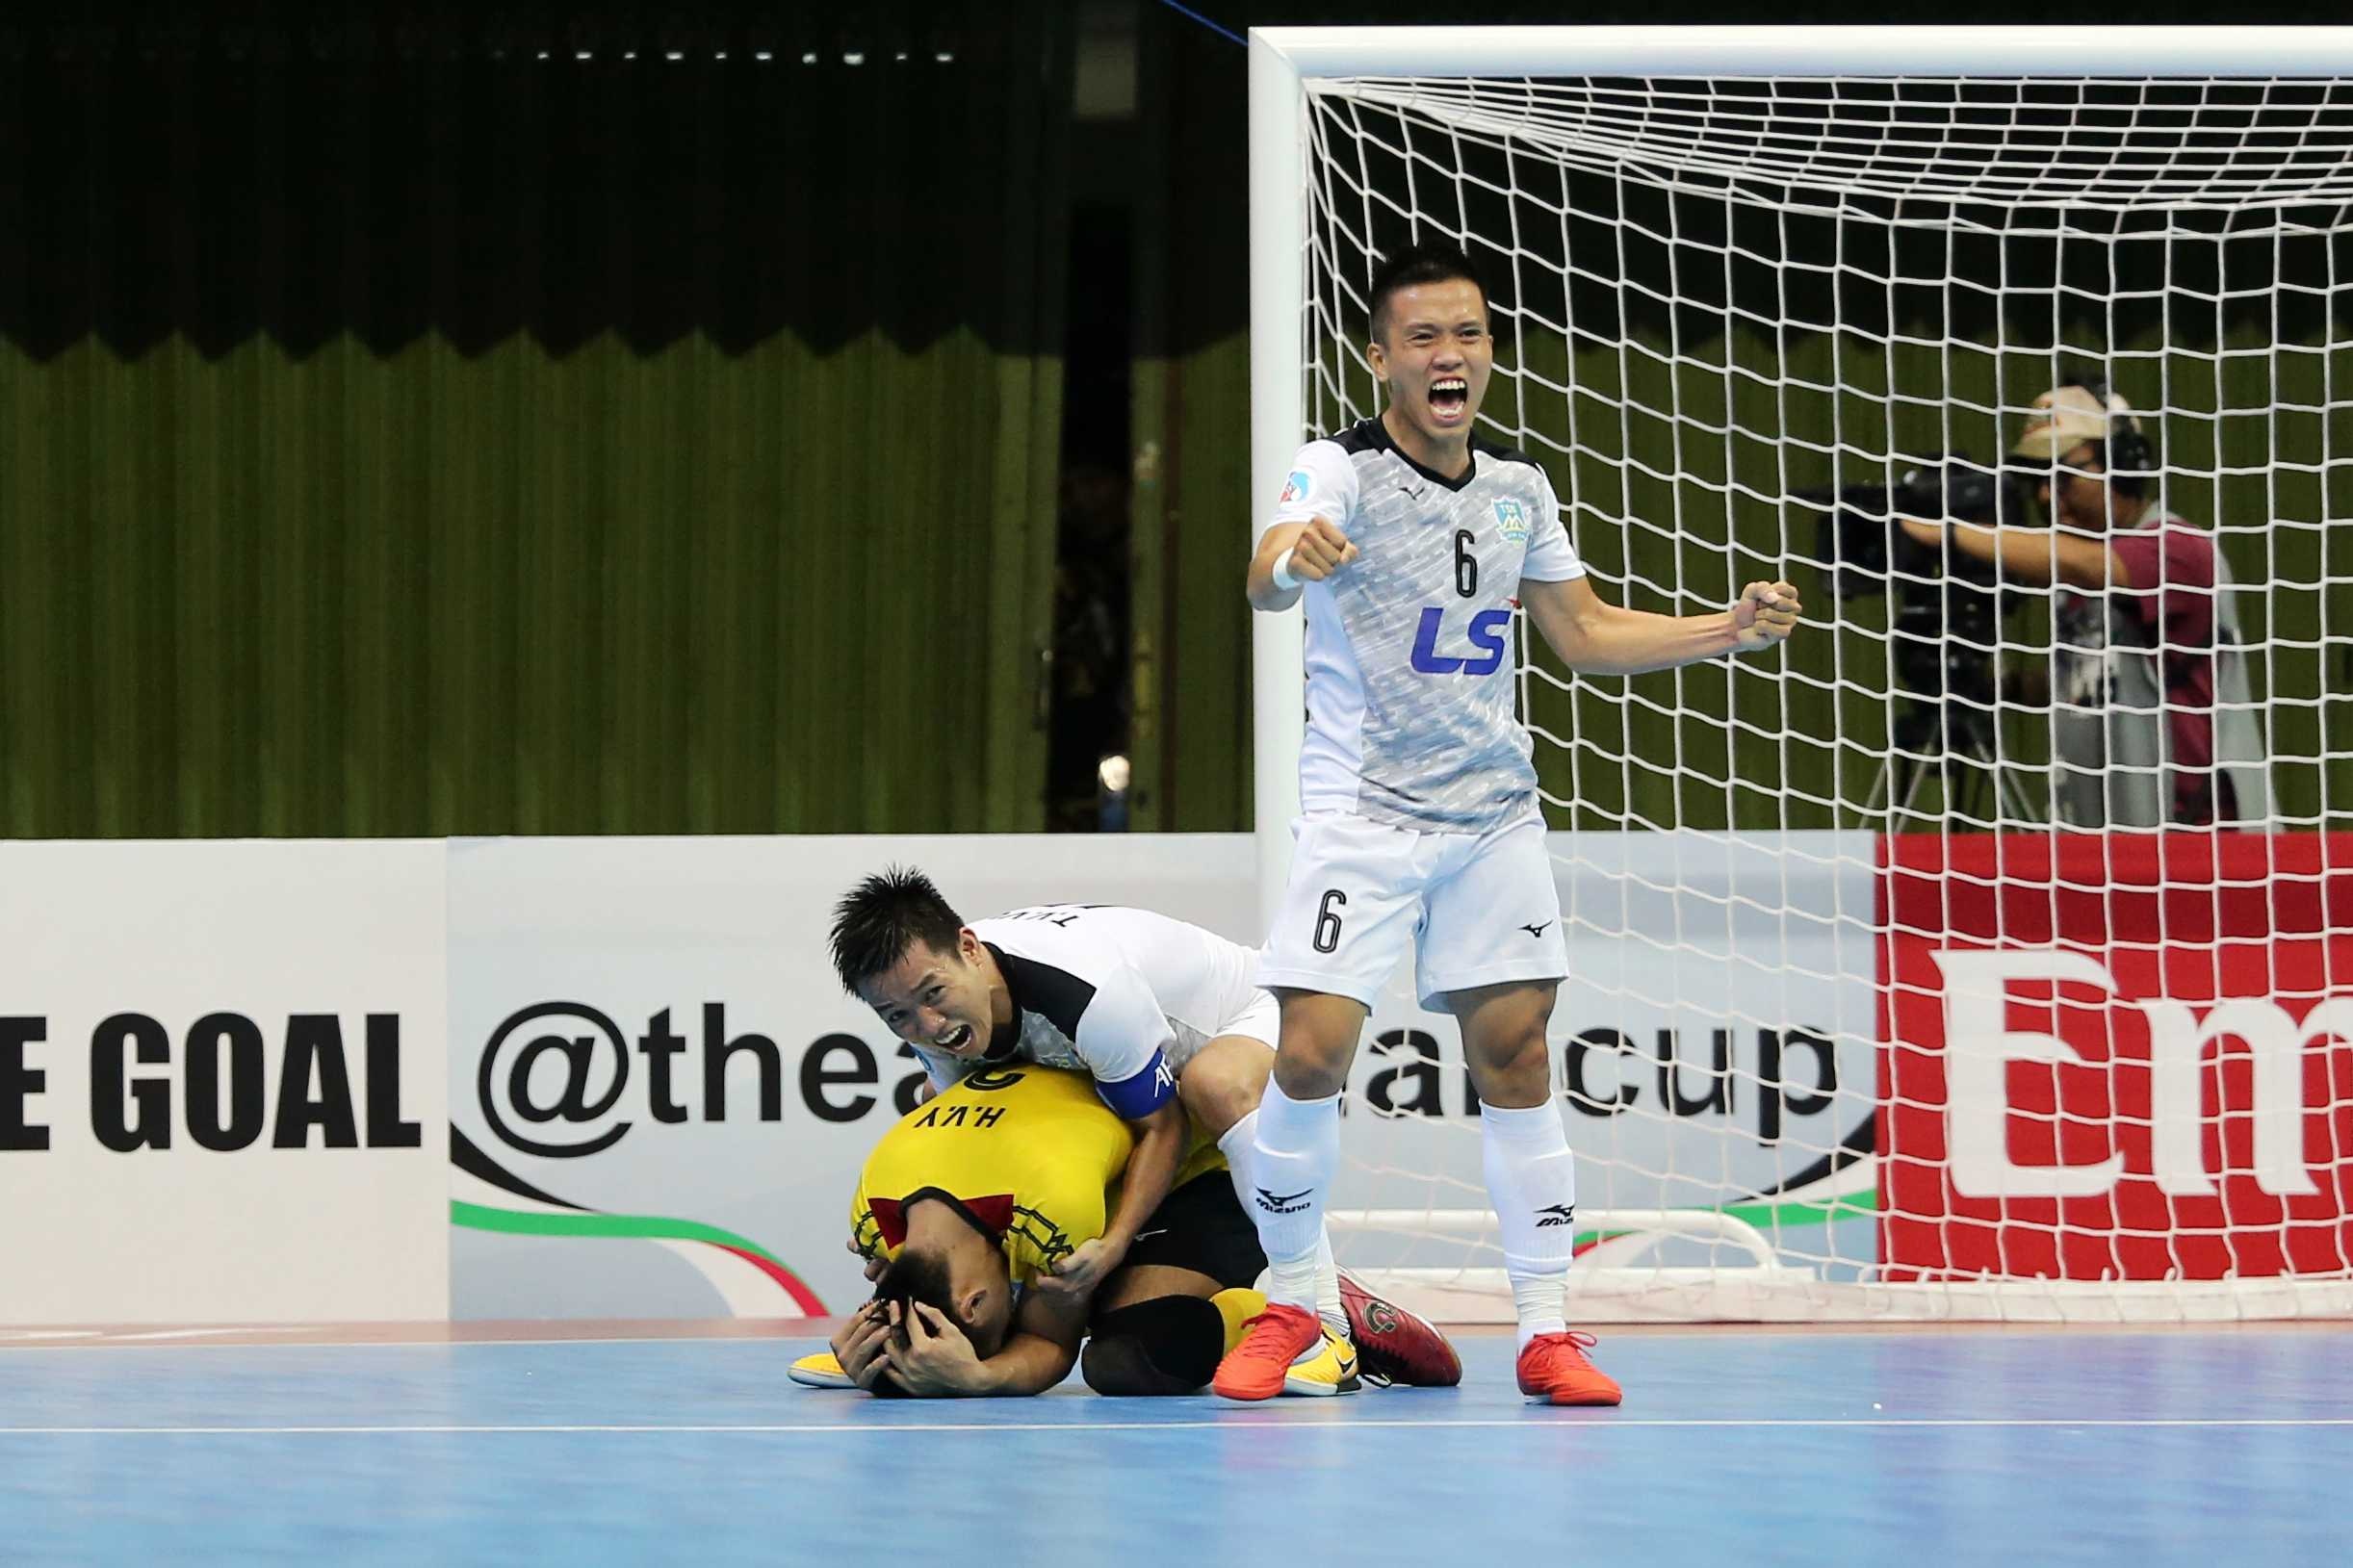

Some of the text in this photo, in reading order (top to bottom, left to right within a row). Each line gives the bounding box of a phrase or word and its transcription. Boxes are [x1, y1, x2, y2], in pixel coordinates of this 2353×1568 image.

[1455, 528, 1478, 599] 6
[1410, 607, 1512, 676] LS
[1313, 889, 1347, 954] 6
[90, 1012, 421, 1152] GOAL
